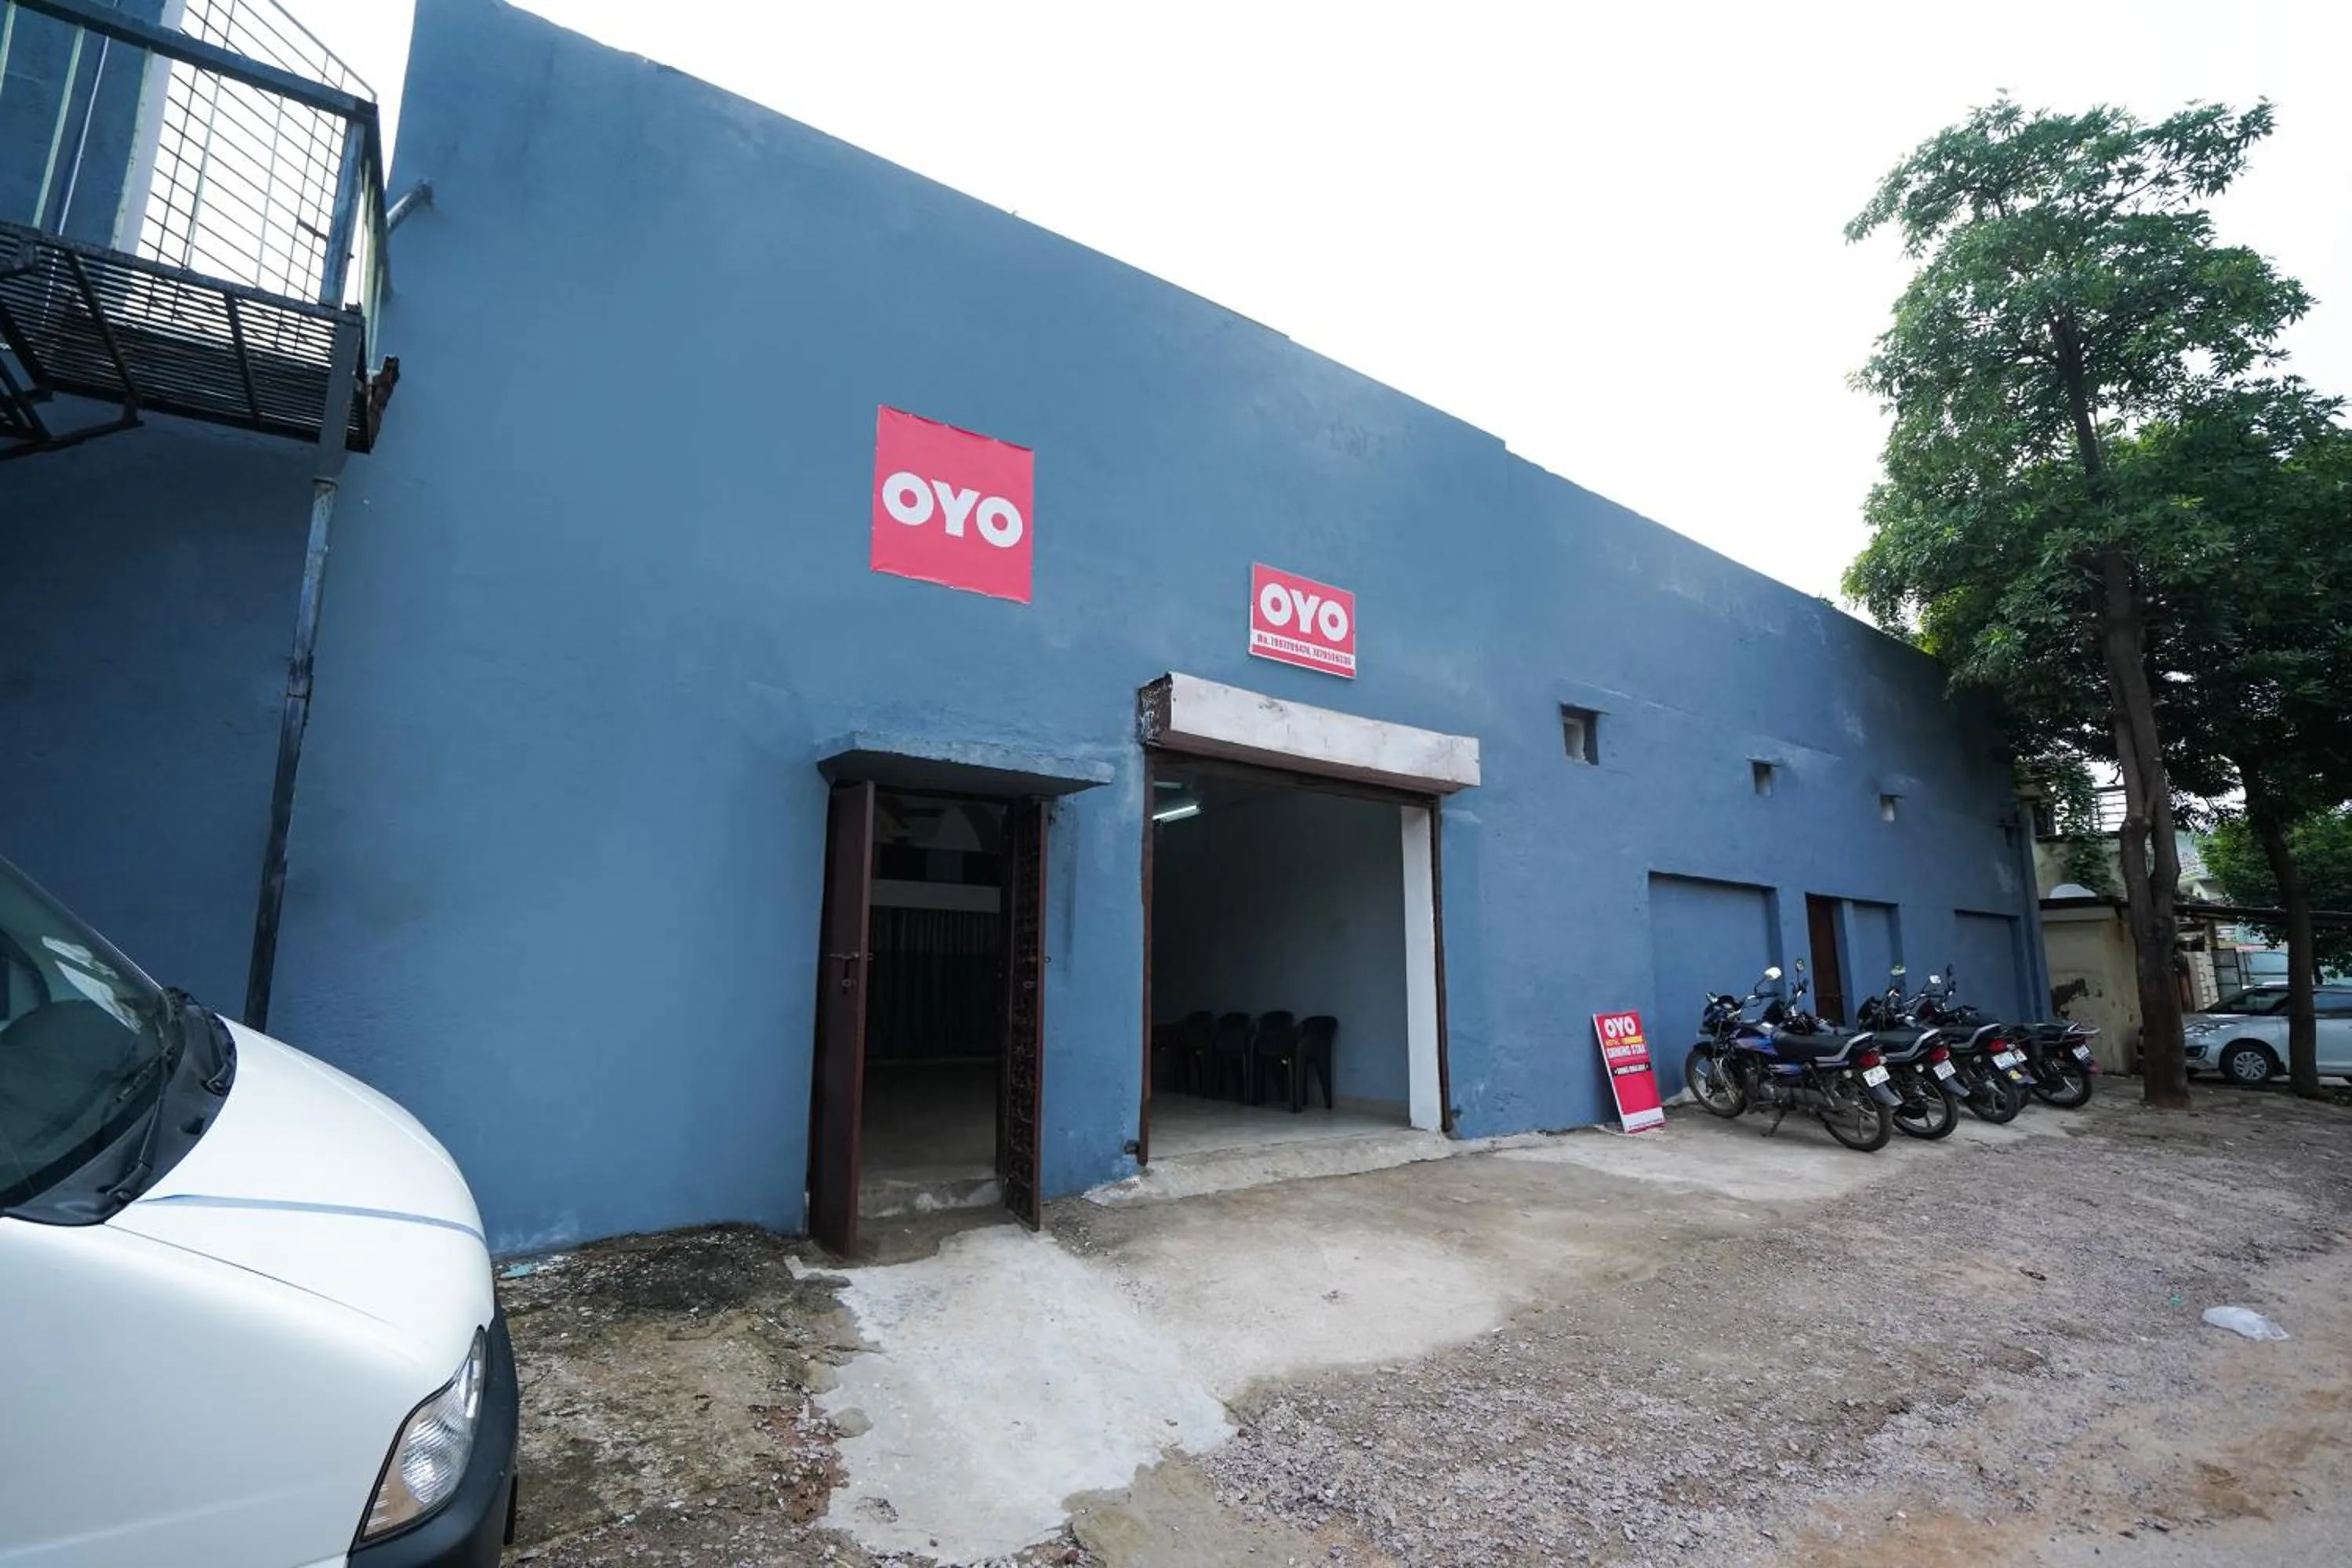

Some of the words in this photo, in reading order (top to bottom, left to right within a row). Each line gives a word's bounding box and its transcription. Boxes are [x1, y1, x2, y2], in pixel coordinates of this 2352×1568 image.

[882, 471, 1023, 548] OYO
[1260, 583, 1348, 642] OYO
[1604, 1015, 1636, 1038] OYO
